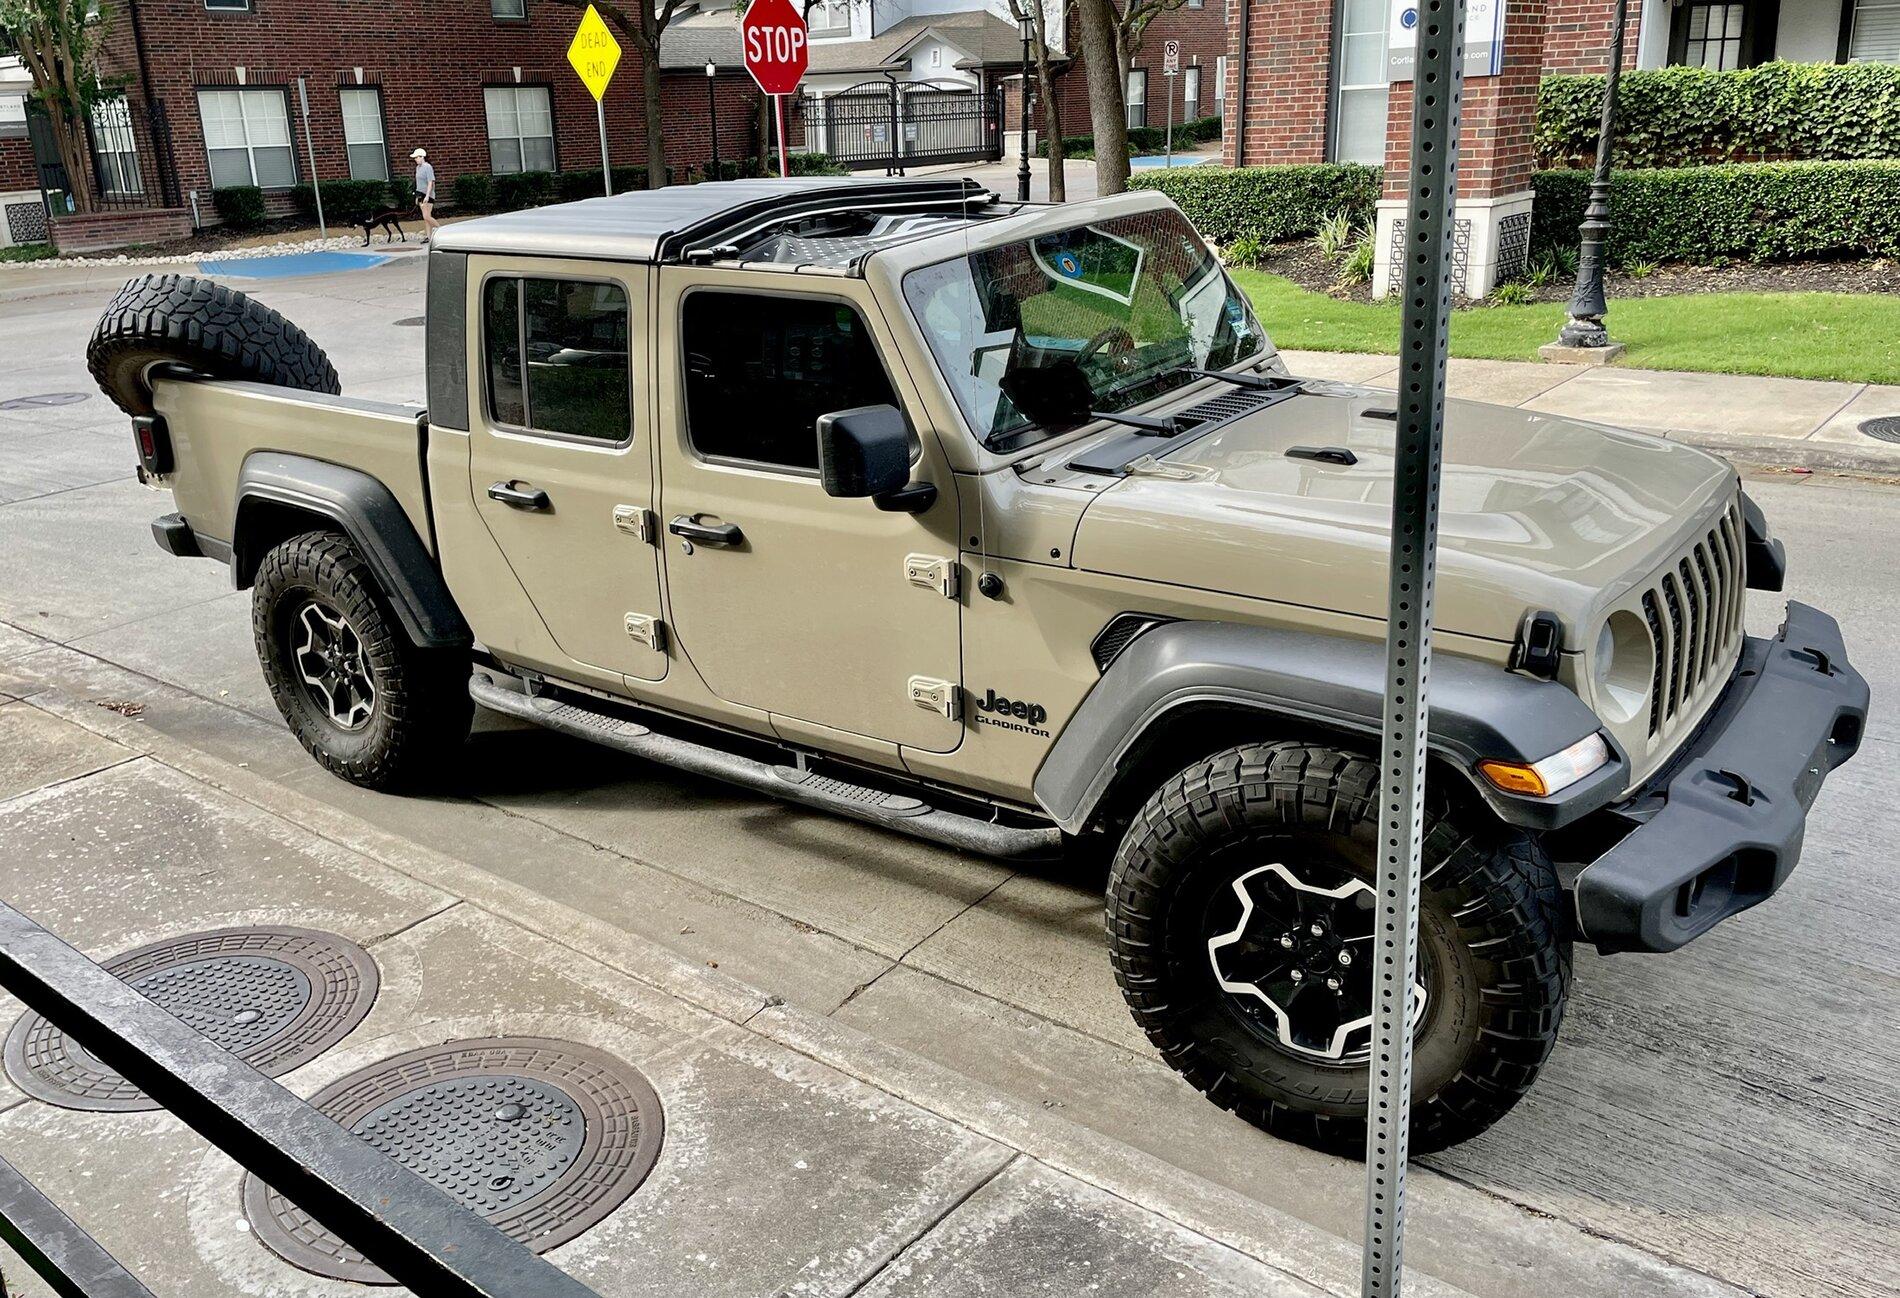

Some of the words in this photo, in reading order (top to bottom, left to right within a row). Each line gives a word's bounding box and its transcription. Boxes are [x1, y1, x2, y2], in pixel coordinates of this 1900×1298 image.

[581, 32, 607, 49] DEAD
[748, 26, 804, 63] STOP
[586, 61, 605, 77] END
[976, 688, 1047, 726] Jeep
[975, 715, 1050, 738] GLADIATOR
